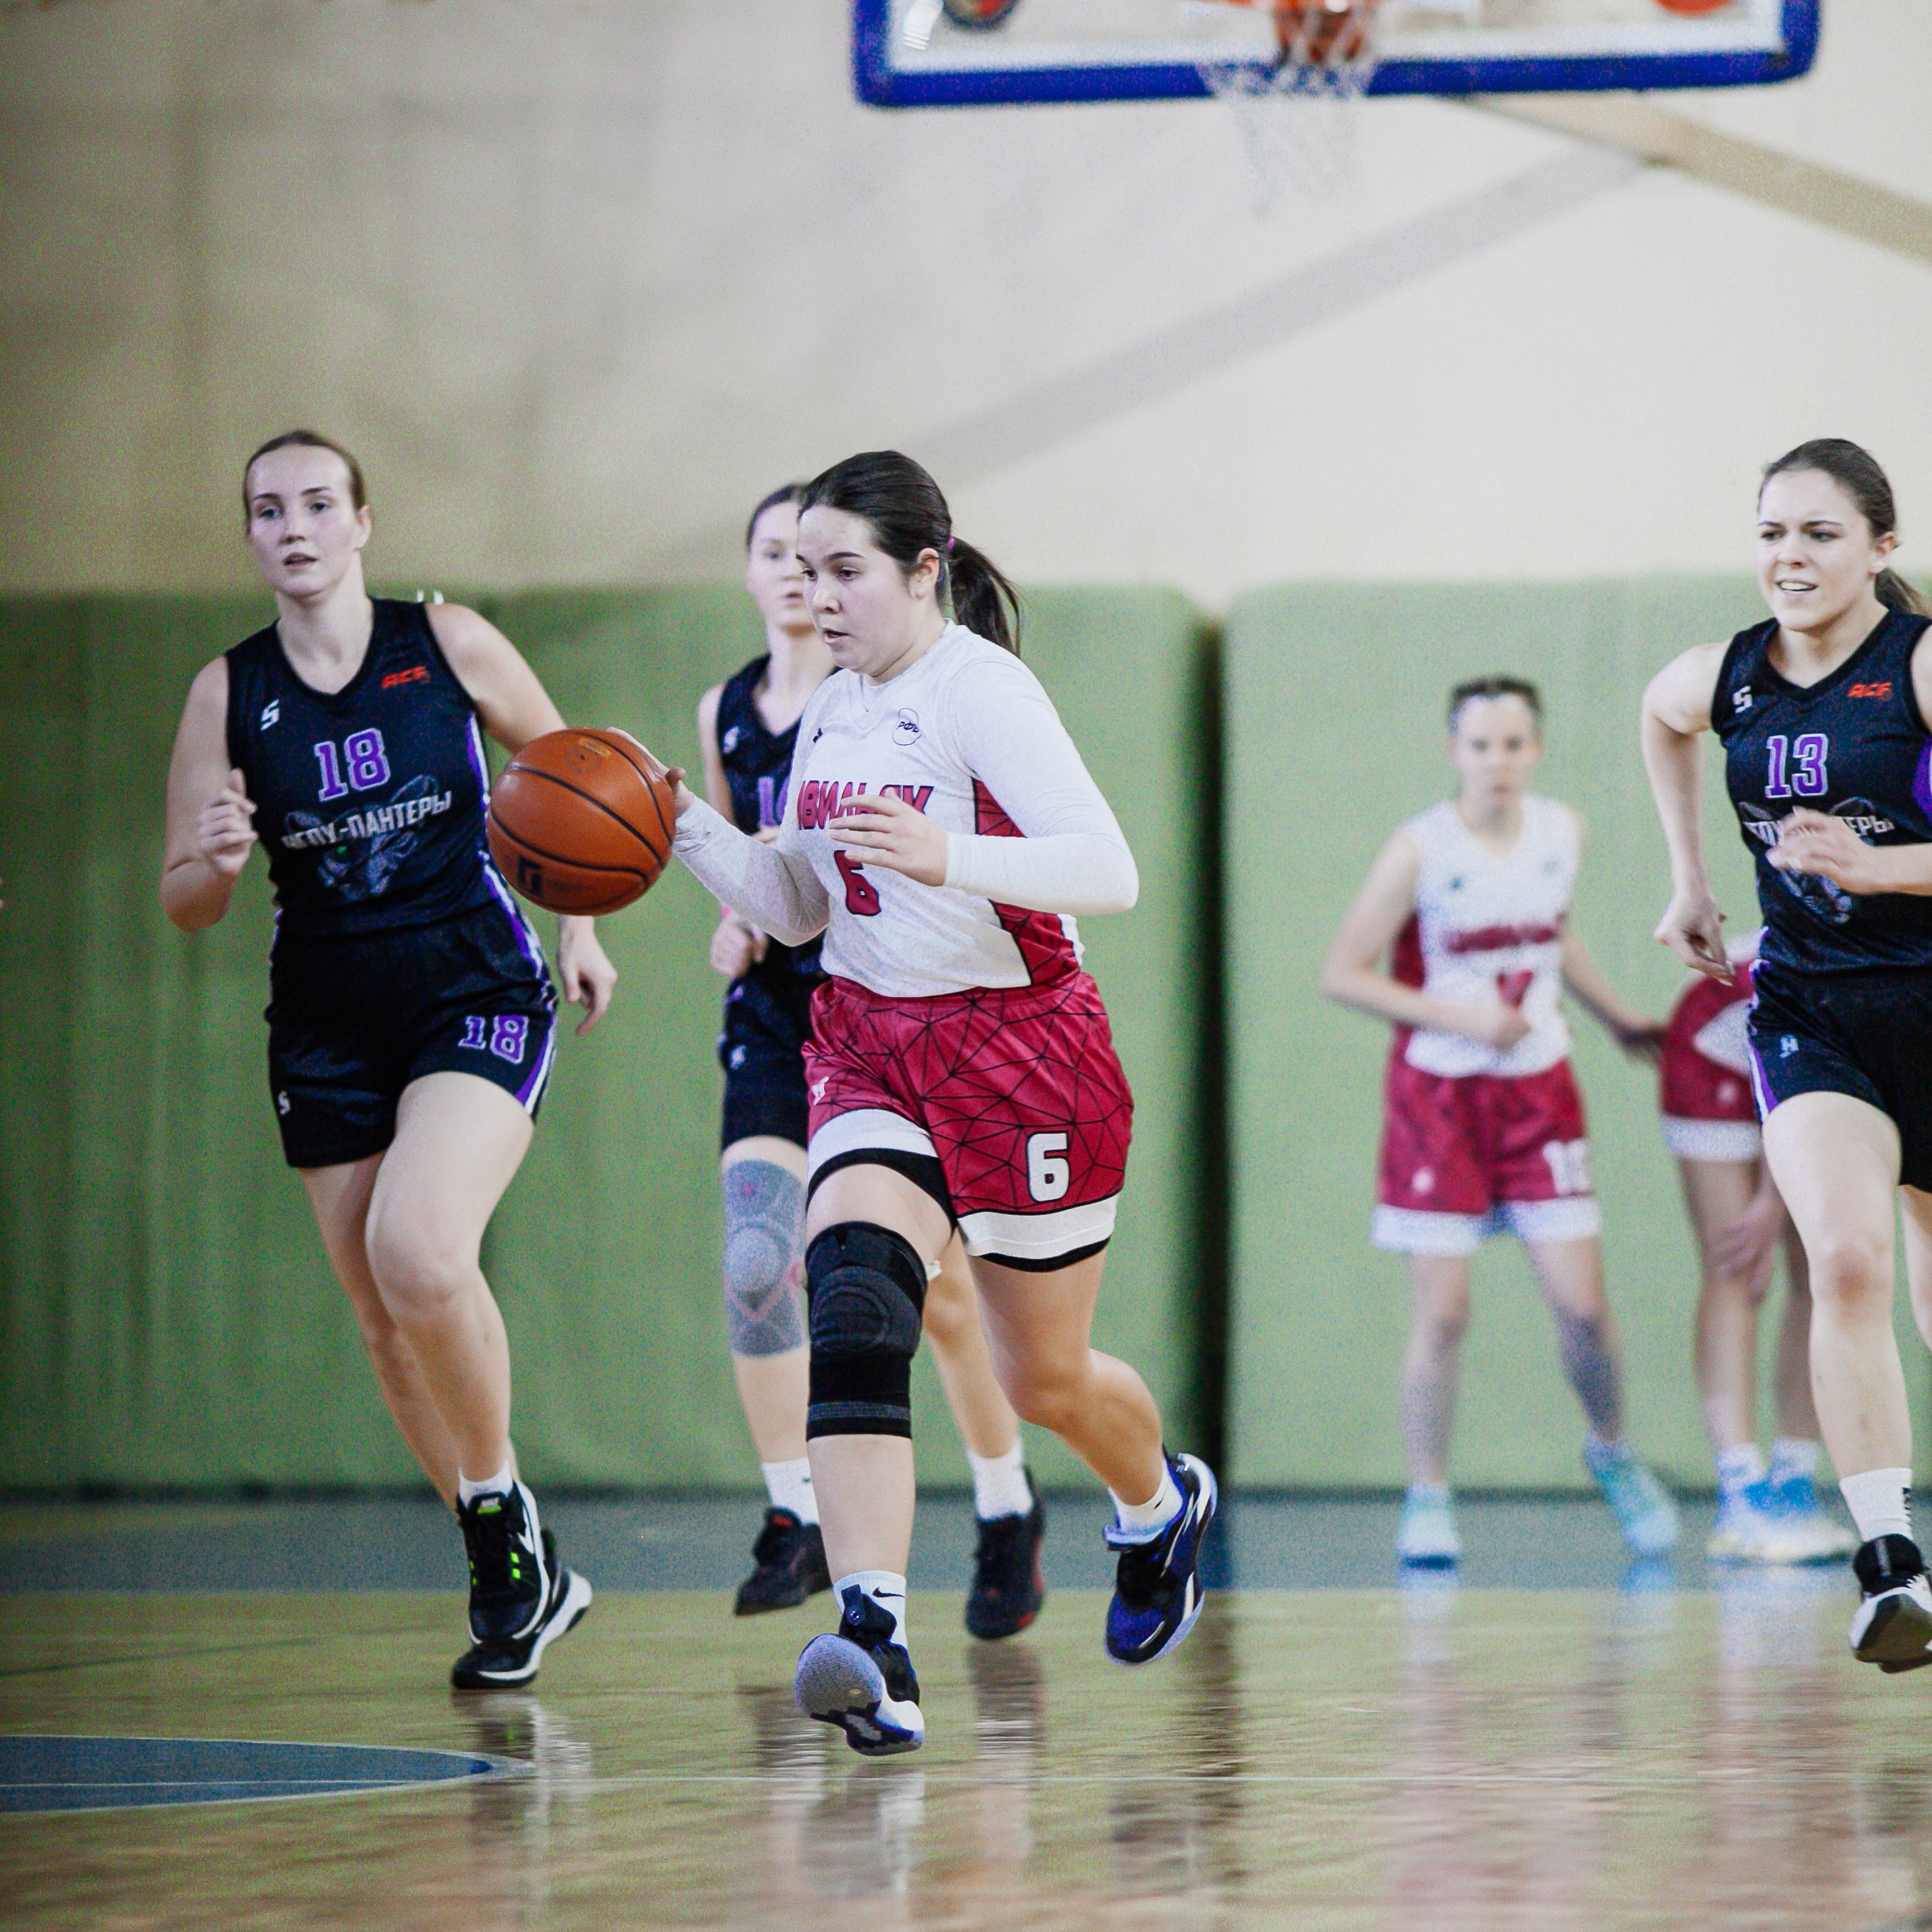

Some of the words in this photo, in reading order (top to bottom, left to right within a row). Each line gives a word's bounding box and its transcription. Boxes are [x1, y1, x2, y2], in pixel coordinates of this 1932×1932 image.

[313, 727, 391, 802] 18
[1764, 733, 1829, 798] 13
[834, 850, 881, 916] 6
[458, 1015, 528, 1064] 18
[1027, 1131, 1069, 1203] 6
